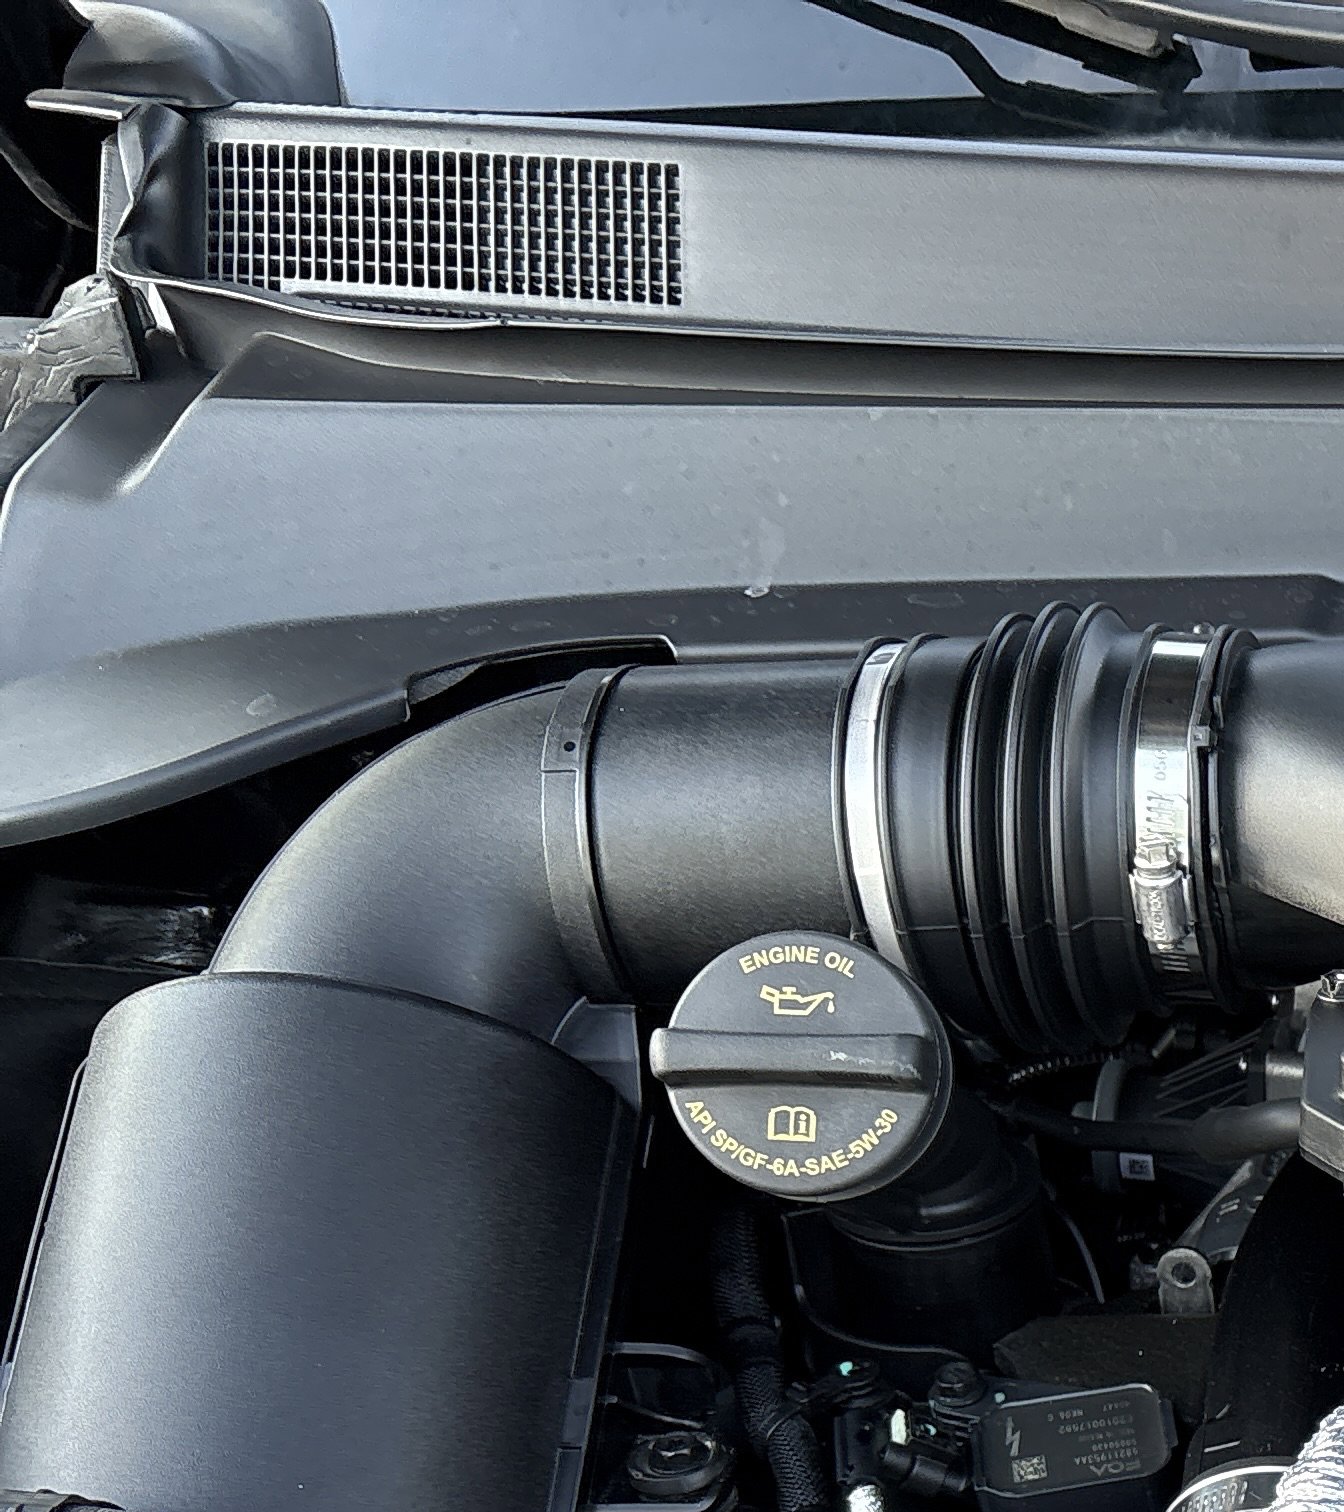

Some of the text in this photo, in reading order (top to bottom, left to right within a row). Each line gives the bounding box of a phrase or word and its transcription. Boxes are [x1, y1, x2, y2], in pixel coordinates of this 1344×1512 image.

[739, 946, 855, 978] ENGINE OIL
[685, 1100, 898, 1178] API SP/GF-6A-SAE-5W-30
